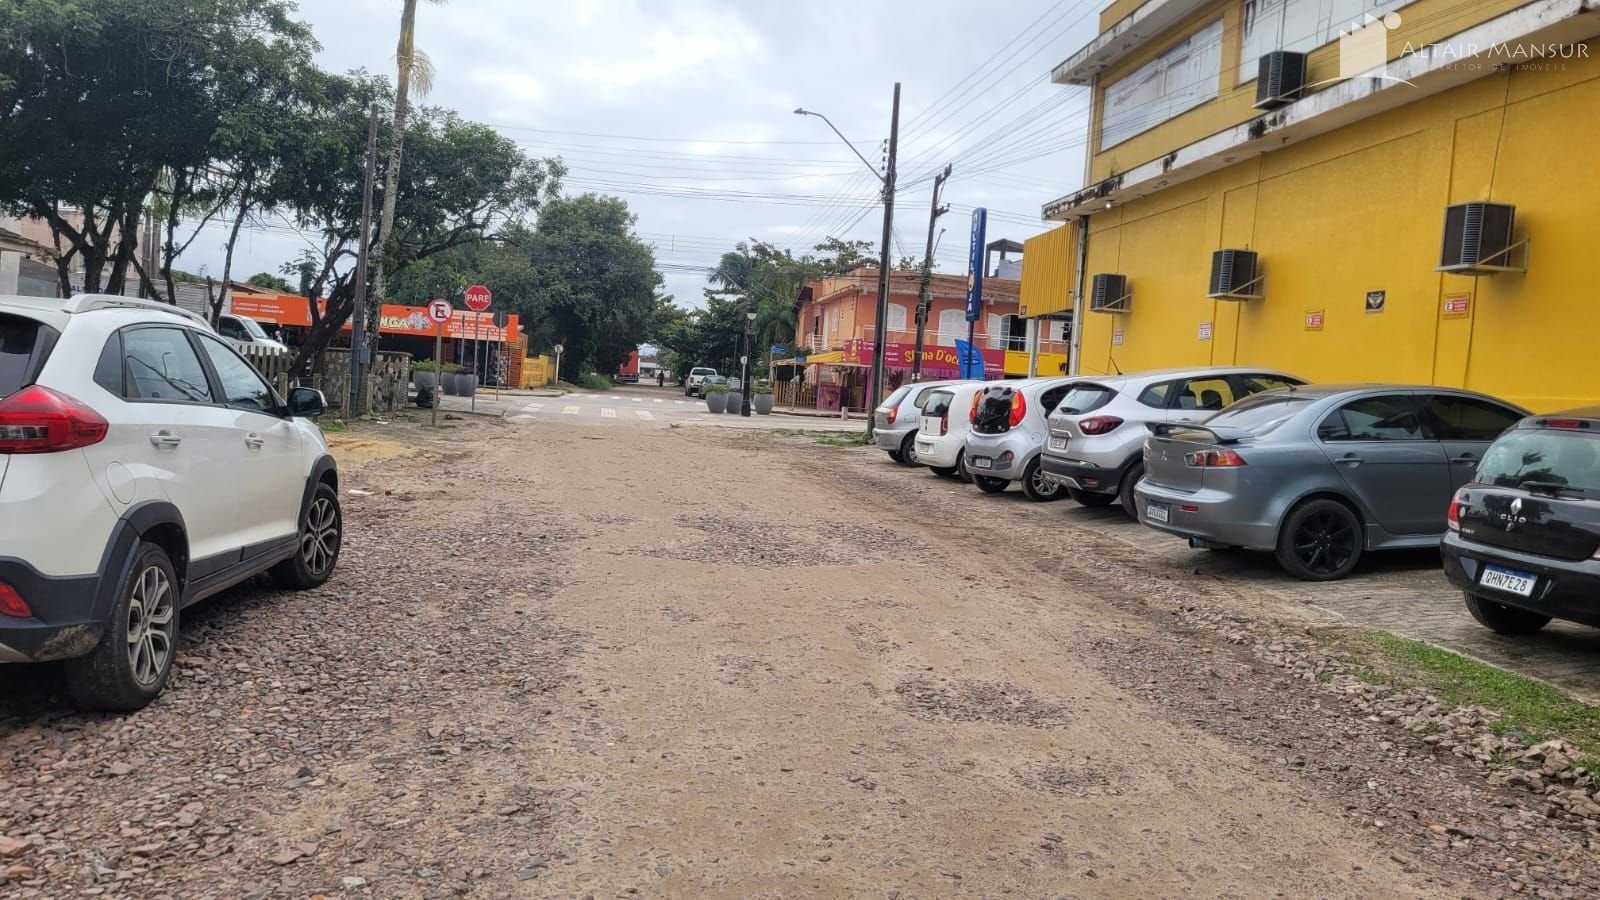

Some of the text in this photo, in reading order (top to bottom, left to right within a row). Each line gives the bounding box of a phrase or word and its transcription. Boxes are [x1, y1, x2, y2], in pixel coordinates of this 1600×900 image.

[467, 294, 490, 303] PARE
[1501, 513, 1527, 524] CLIO
[1486, 571, 1528, 593] QHN7E28
